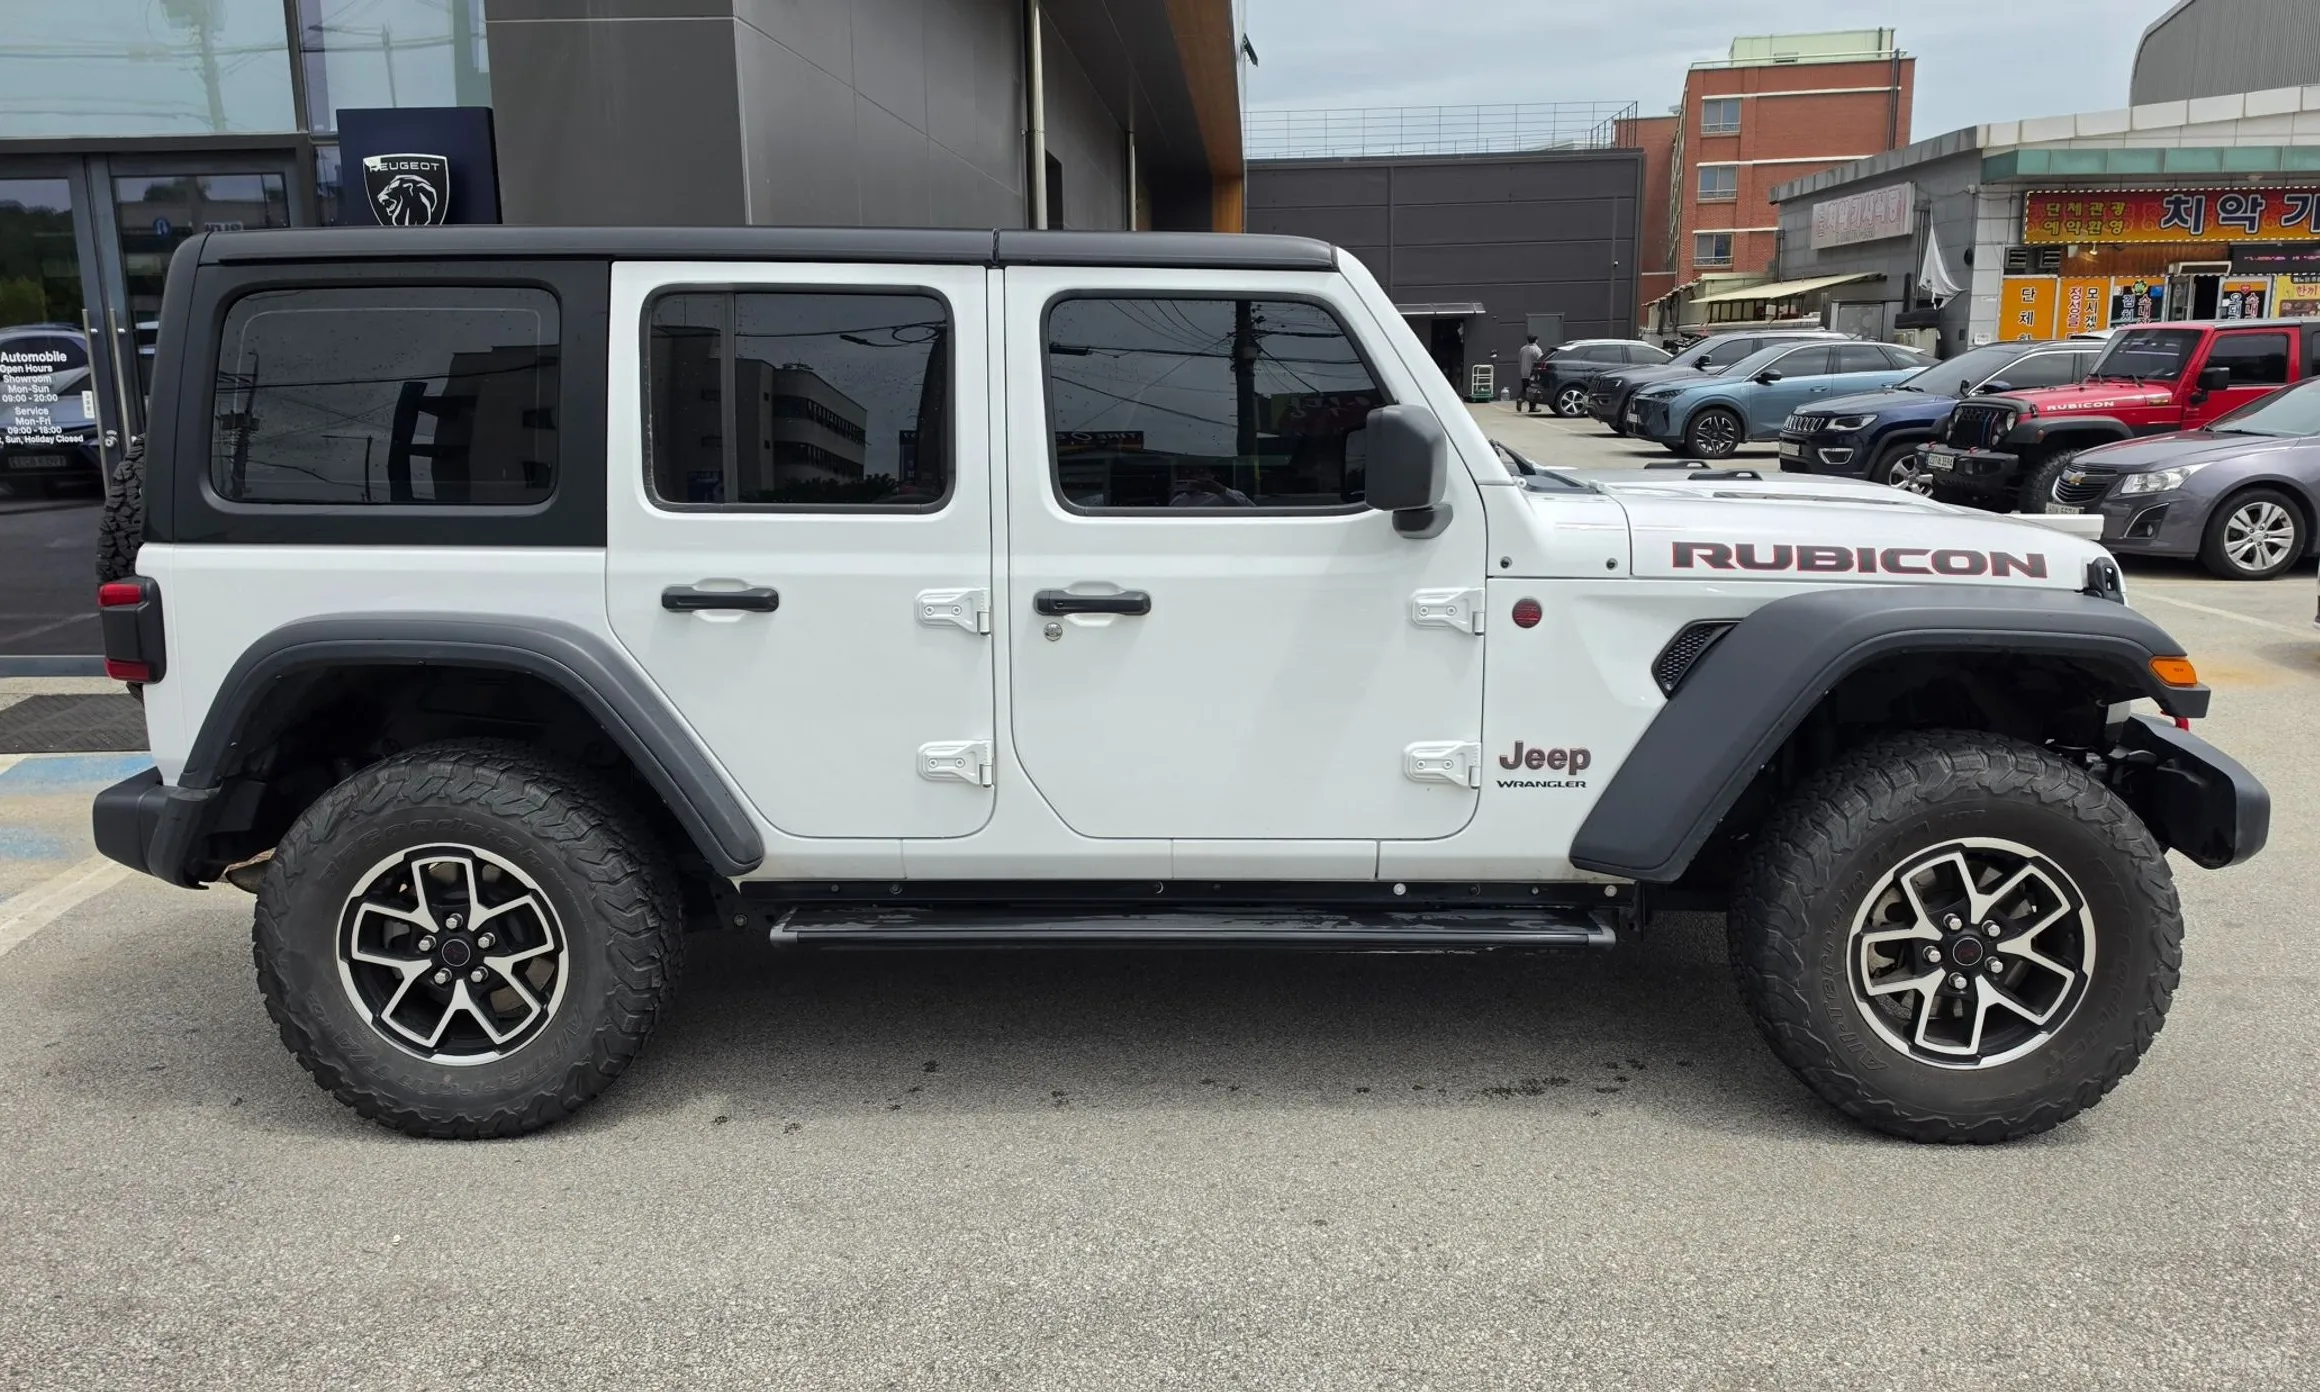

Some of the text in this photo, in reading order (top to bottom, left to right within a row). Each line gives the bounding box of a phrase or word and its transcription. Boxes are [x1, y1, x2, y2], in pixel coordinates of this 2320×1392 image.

[1, 351, 67, 362] Automobile
[0, 364, 53, 374] Open Hours
[3, 374, 52, 383] Showroom
[8, 384, 50, 393] Mon-Sun
[15, 407, 49, 415] Service
[2046, 401, 2115, 411] RUBICON
[15, 417, 51, 425] Mon-Fri
[25, 435, 55, 445] Holiday
[55, 434, 84, 443] Closed
[1672, 541, 2048, 578] RUBICON
[1499, 740, 1591, 775] Jeep
[1497, 780, 1587, 788] WRANGLER
